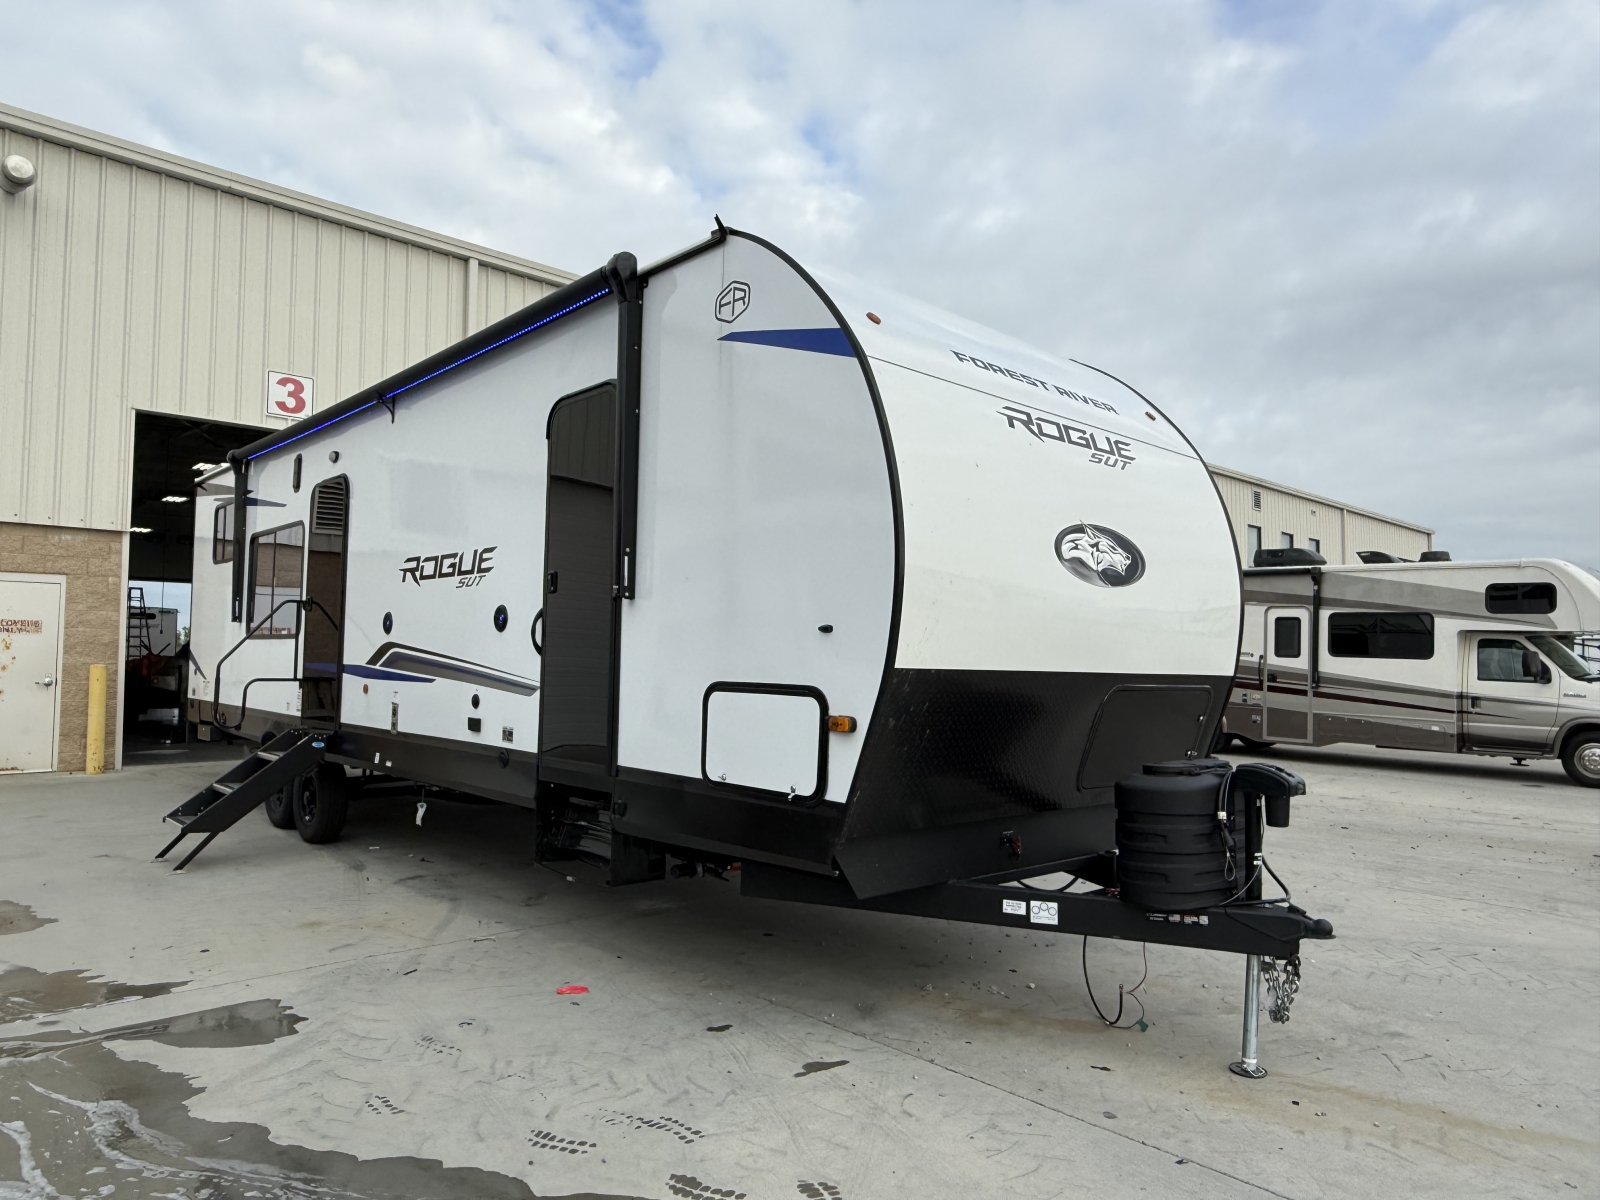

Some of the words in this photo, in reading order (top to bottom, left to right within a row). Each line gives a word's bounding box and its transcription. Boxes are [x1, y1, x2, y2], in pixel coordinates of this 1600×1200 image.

[718, 286, 747, 317] FR
[275, 377, 306, 414] 3
[950, 350, 1050, 391] FOREST
[1051, 384, 1120, 416] RIVER
[996, 405, 1136, 461] ROGUE
[1088, 452, 1132, 471] SUT
[399, 546, 498, 587] ROGUE
[456, 575, 486, 588] SUT
